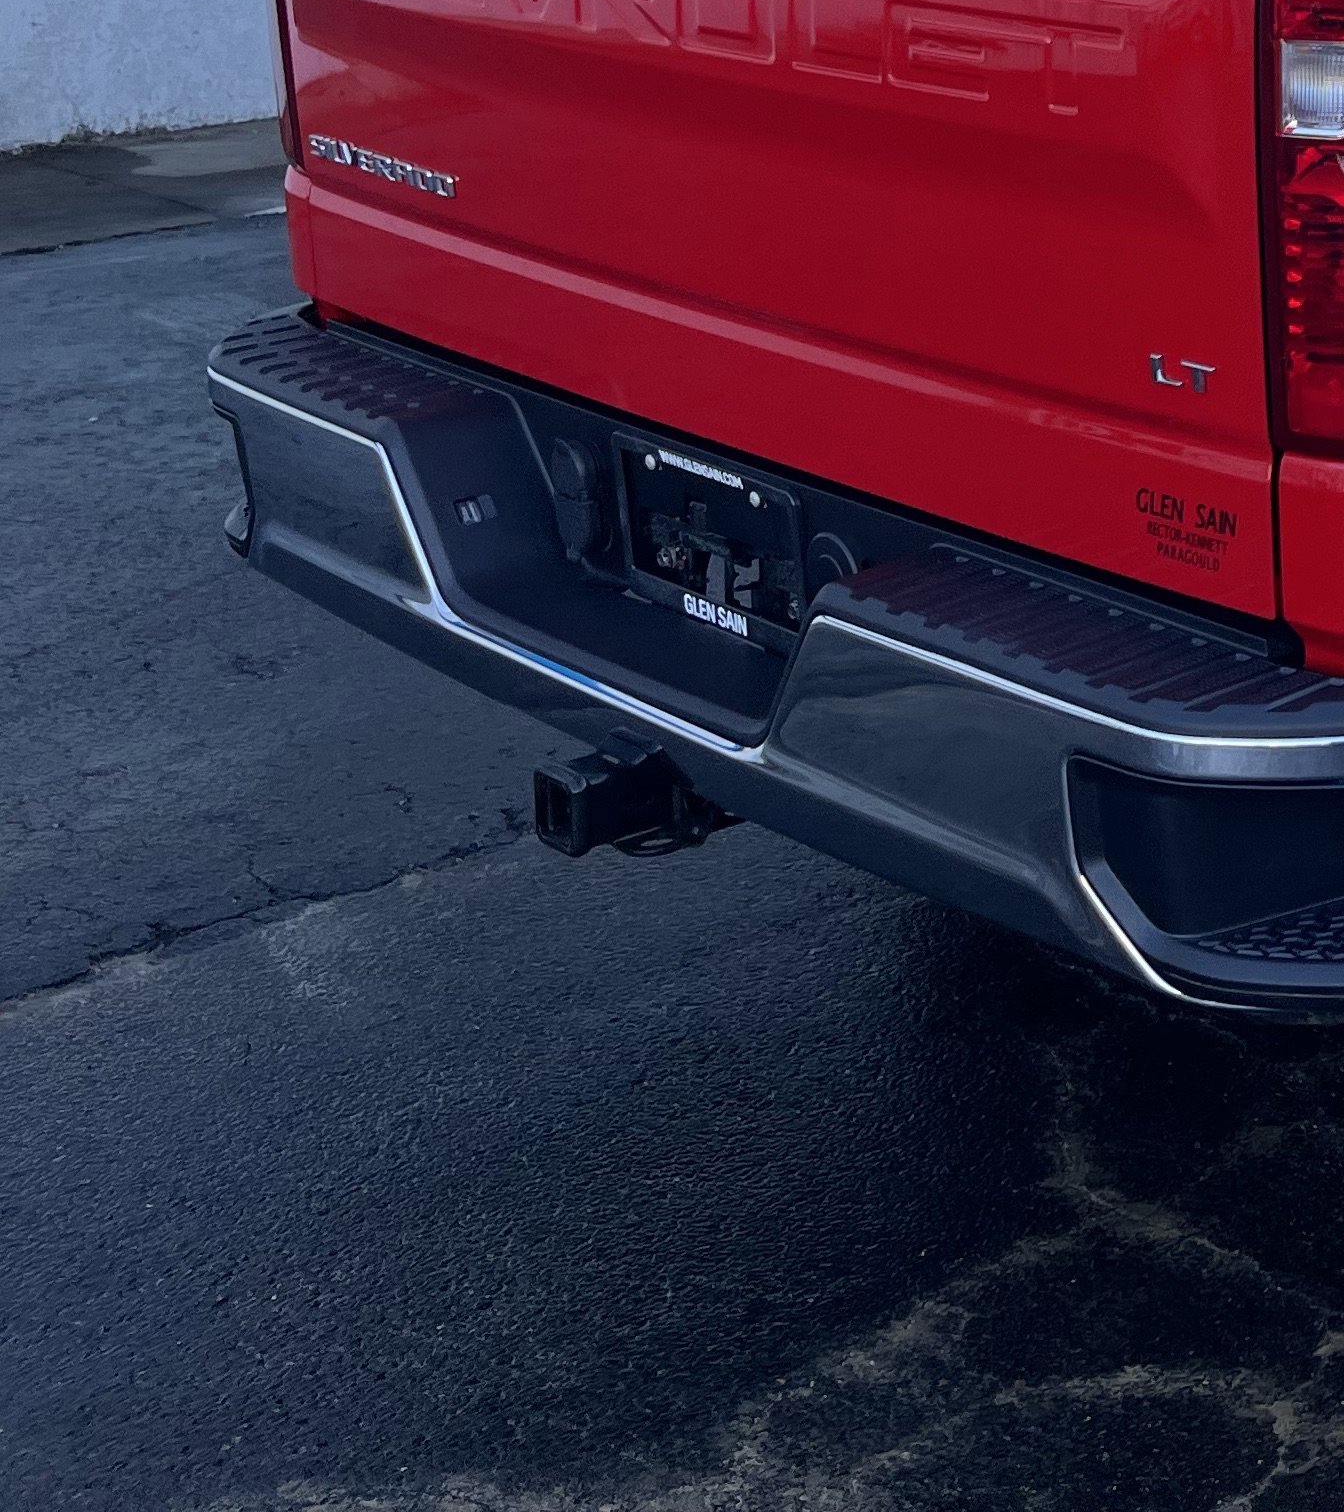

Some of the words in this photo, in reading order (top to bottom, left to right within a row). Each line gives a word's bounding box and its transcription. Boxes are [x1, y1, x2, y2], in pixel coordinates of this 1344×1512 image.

[308, 133, 458, 199] SILVERADO
[1149, 352, 1216, 394] LT
[1135, 487, 1185, 523] GLEN
[1194, 503, 1238, 537] SAIN
[1156, 540, 1221, 573] PARAGOULD
[683, 592, 718, 625] GLEN
[717, 605, 748, 638] SAIN
